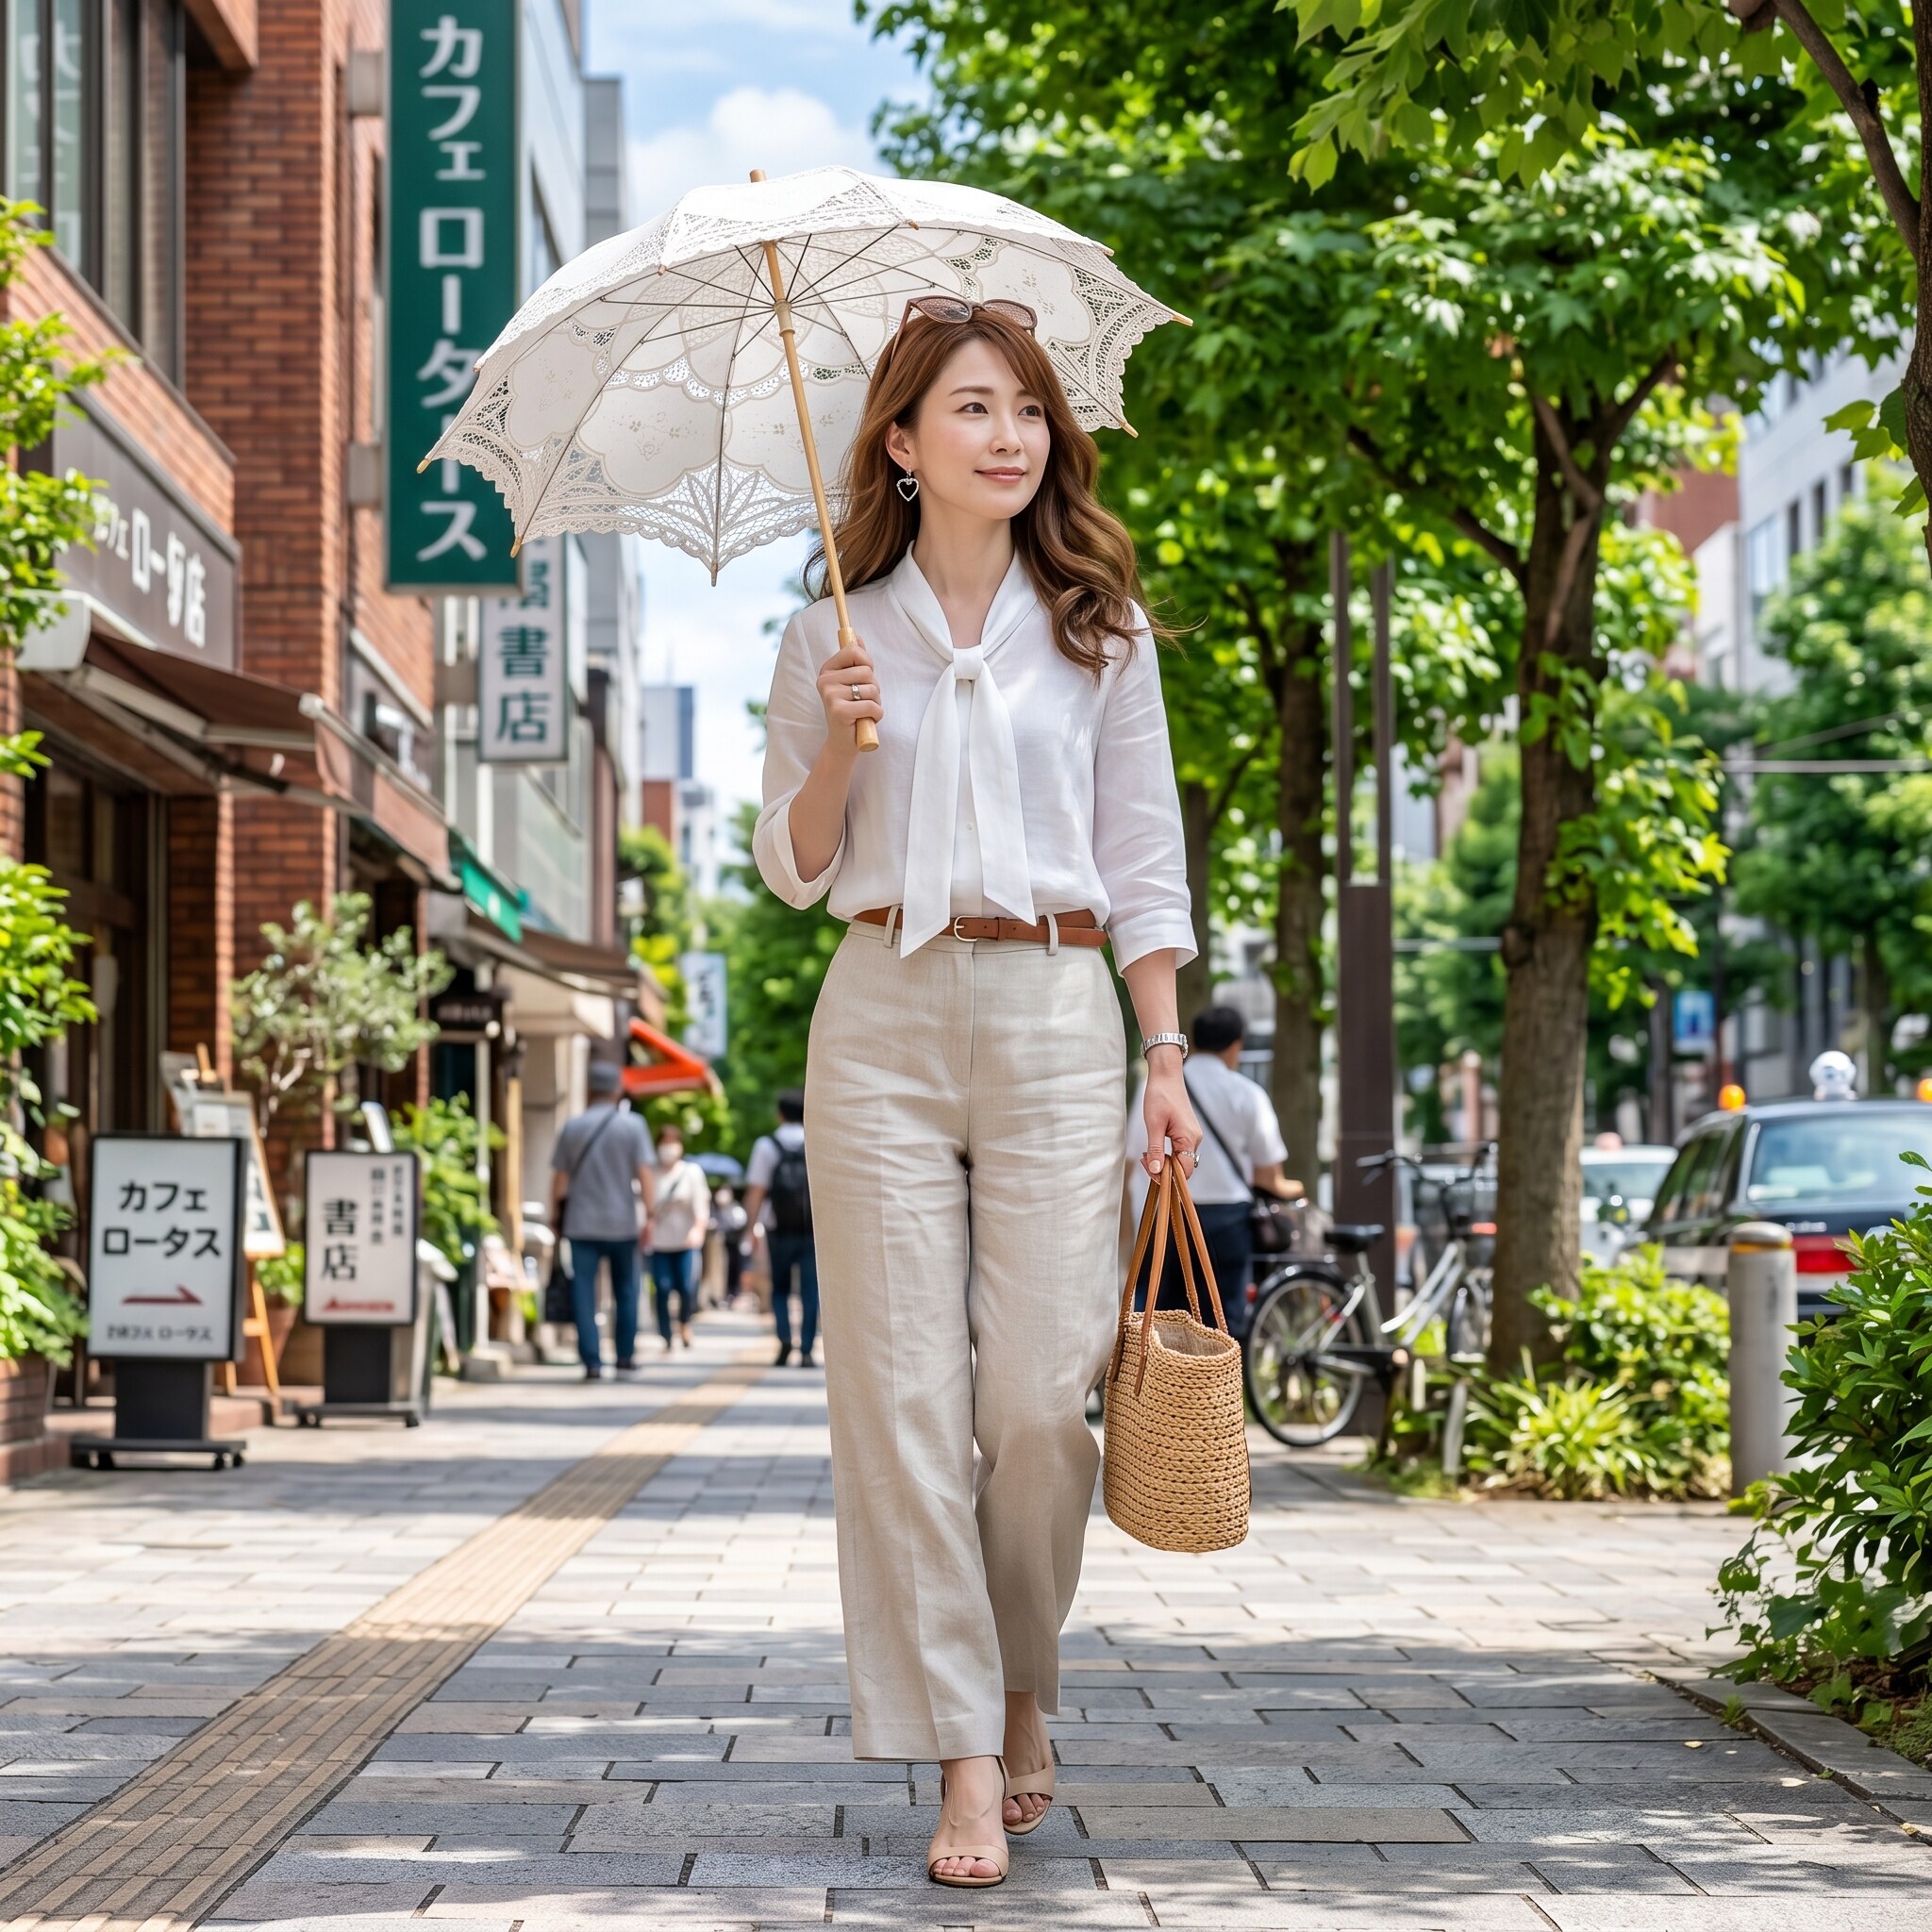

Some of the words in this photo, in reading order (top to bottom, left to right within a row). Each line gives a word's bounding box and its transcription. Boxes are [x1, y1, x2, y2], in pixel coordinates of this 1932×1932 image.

[419, 15, 487, 180] カフェ
[119, 1180, 208, 1212] カフェ
[102, 1225, 221, 1257] ロータス
[322, 1198, 358, 1280] 書店
